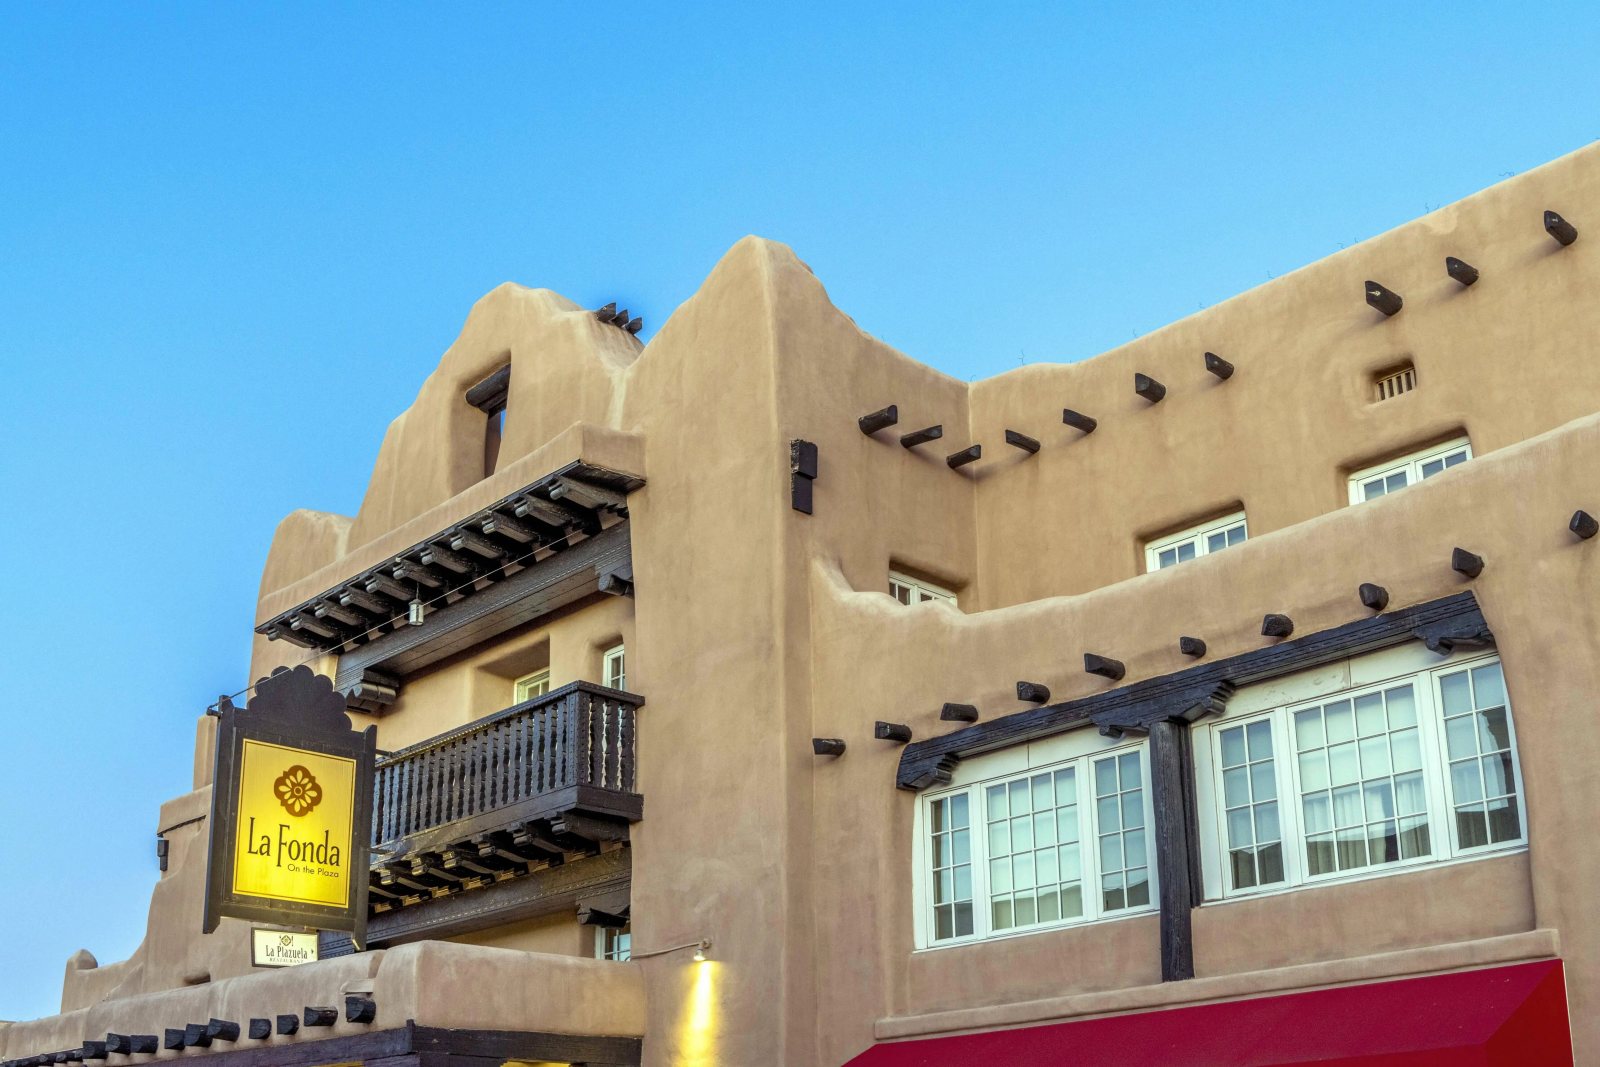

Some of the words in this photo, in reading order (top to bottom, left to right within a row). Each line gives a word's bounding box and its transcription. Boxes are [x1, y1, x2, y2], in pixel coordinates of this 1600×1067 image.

[248, 817, 270, 856] La
[276, 824, 340, 867] Fonda
[287, 864, 300, 872] On
[303, 866, 315, 875] the
[318, 868, 339, 878] Plaza
[266, 945, 275, 957] La
[277, 946, 308, 959] Plazuela
